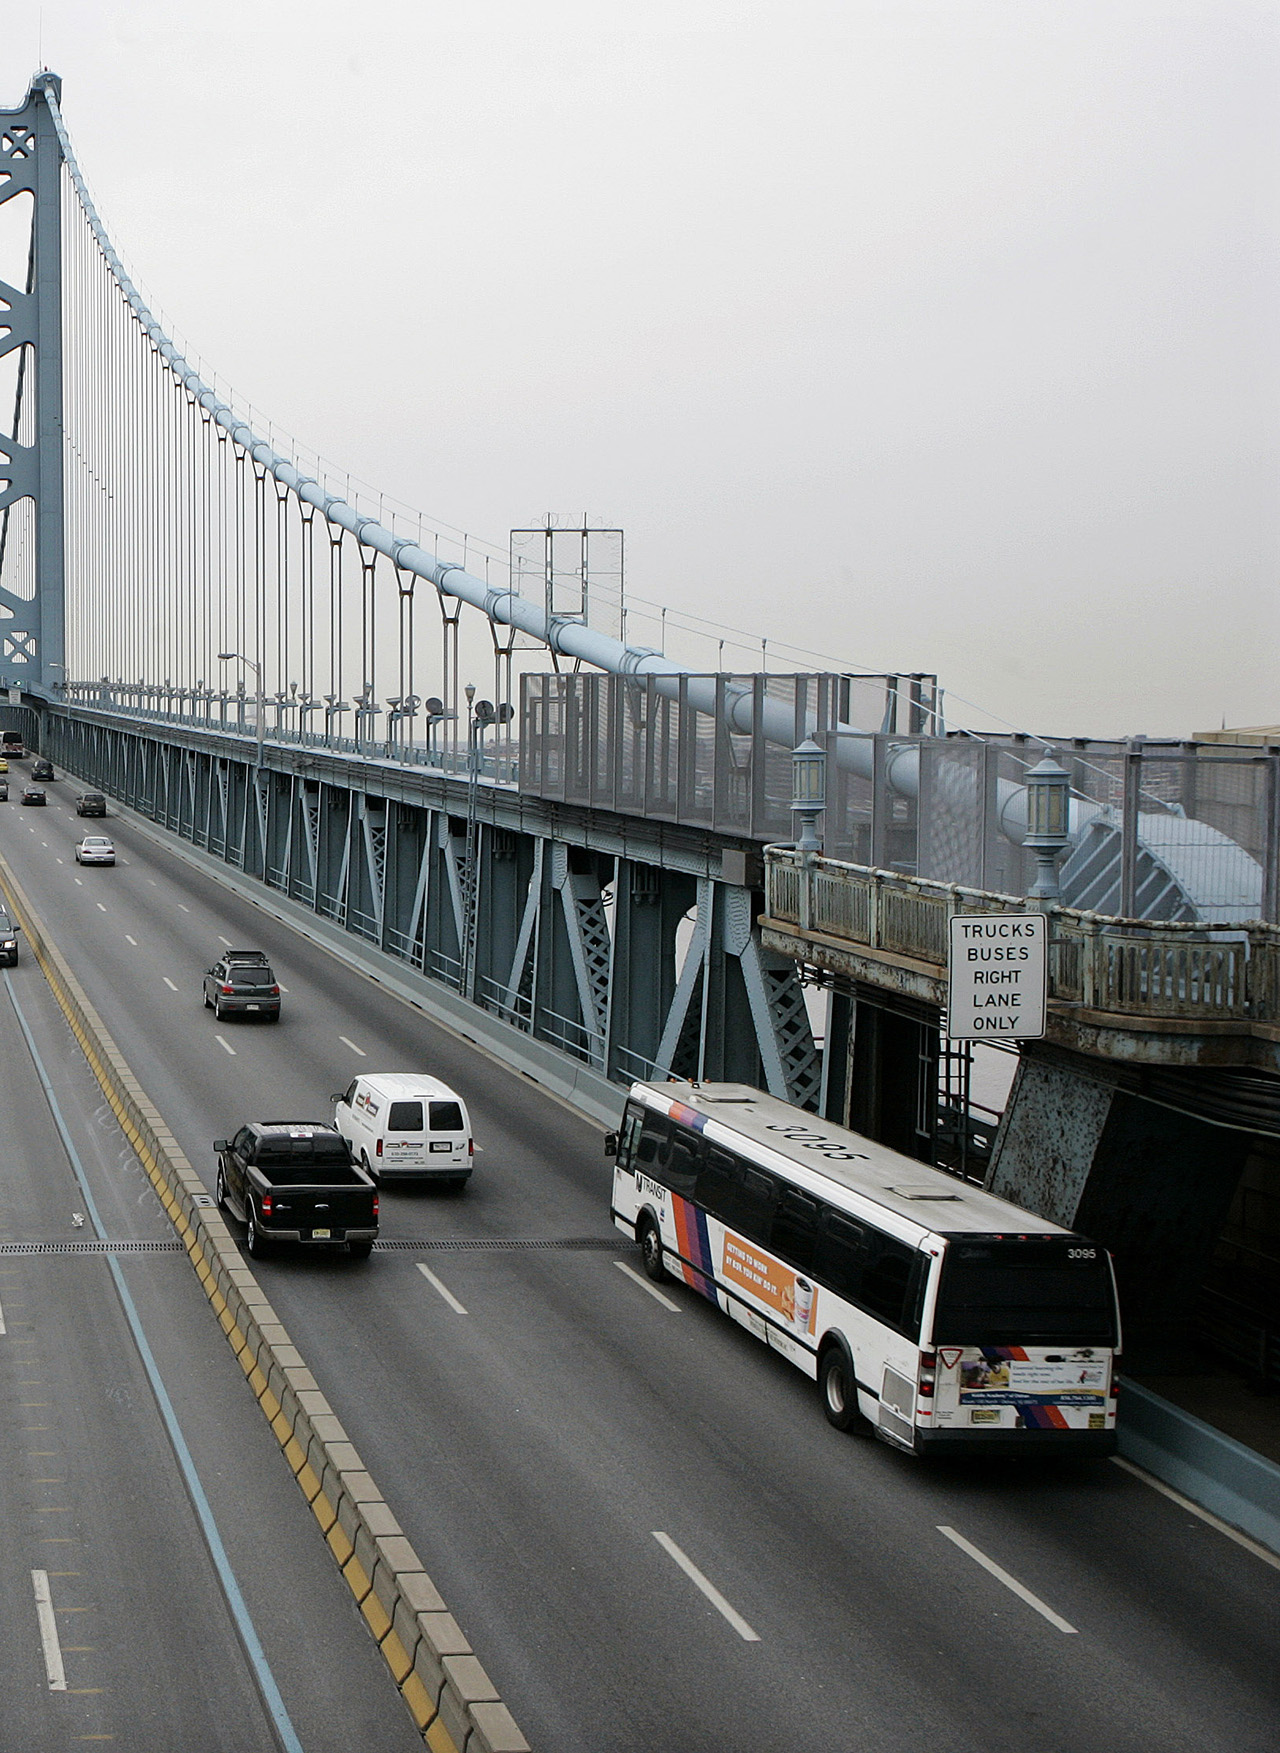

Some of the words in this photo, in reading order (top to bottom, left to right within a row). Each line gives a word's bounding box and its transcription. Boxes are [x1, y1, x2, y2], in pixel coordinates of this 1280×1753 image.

[961, 923, 1035, 938] TRUCKS
[967, 947, 1029, 961] BUSES
[974, 970, 1022, 984] RIGHT
[973, 993, 1022, 1007] LANE
[973, 1016, 1020, 1030] ONLY
[765, 1125, 871, 1160] 3095
[642, 1176, 667, 1202] TRANSIT
[1068, 1249, 1097, 1259] 3095
